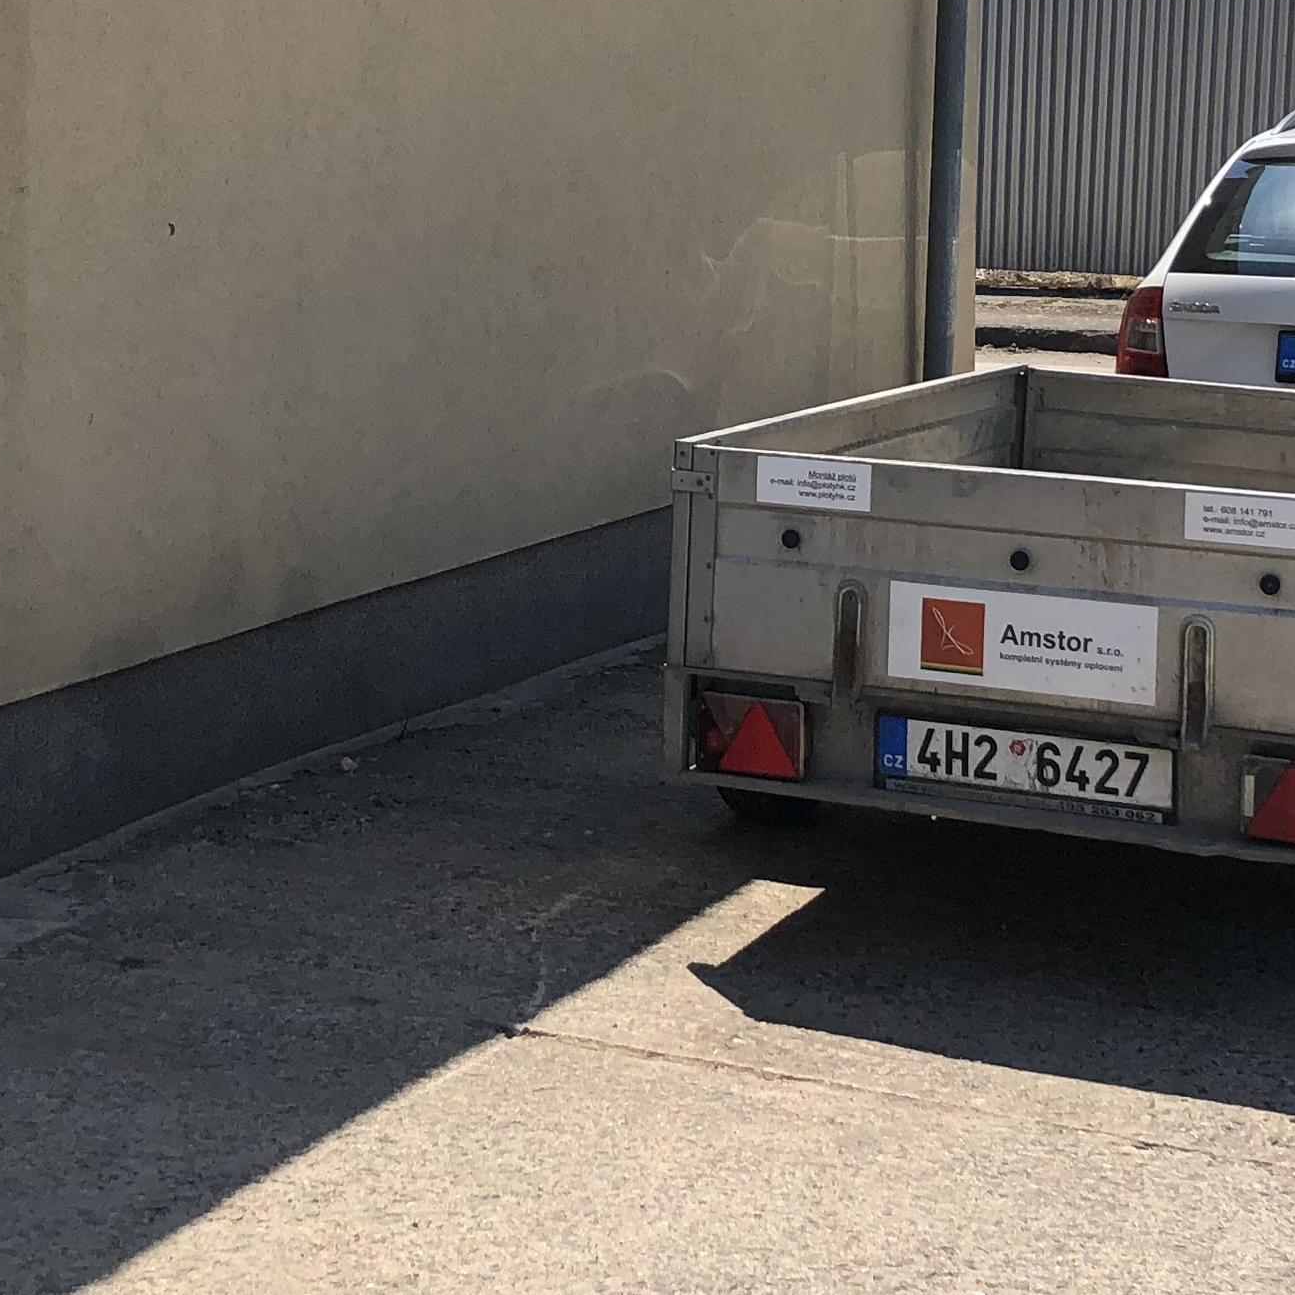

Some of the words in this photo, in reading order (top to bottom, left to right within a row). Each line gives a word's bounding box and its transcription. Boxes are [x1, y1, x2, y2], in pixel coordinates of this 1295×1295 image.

[1239, 507, 1254, 516] 141
[1257, 508, 1273, 517] 791
[1000, 624, 1093, 653] Amstor
[1096, 647, 1124, 657] s.r.o.
[1045, 657, 1082, 669] systémy
[883, 753, 904, 769] CZ
[917, 728, 998, 781] 4H2
[1035, 741, 1150, 798] 6427
